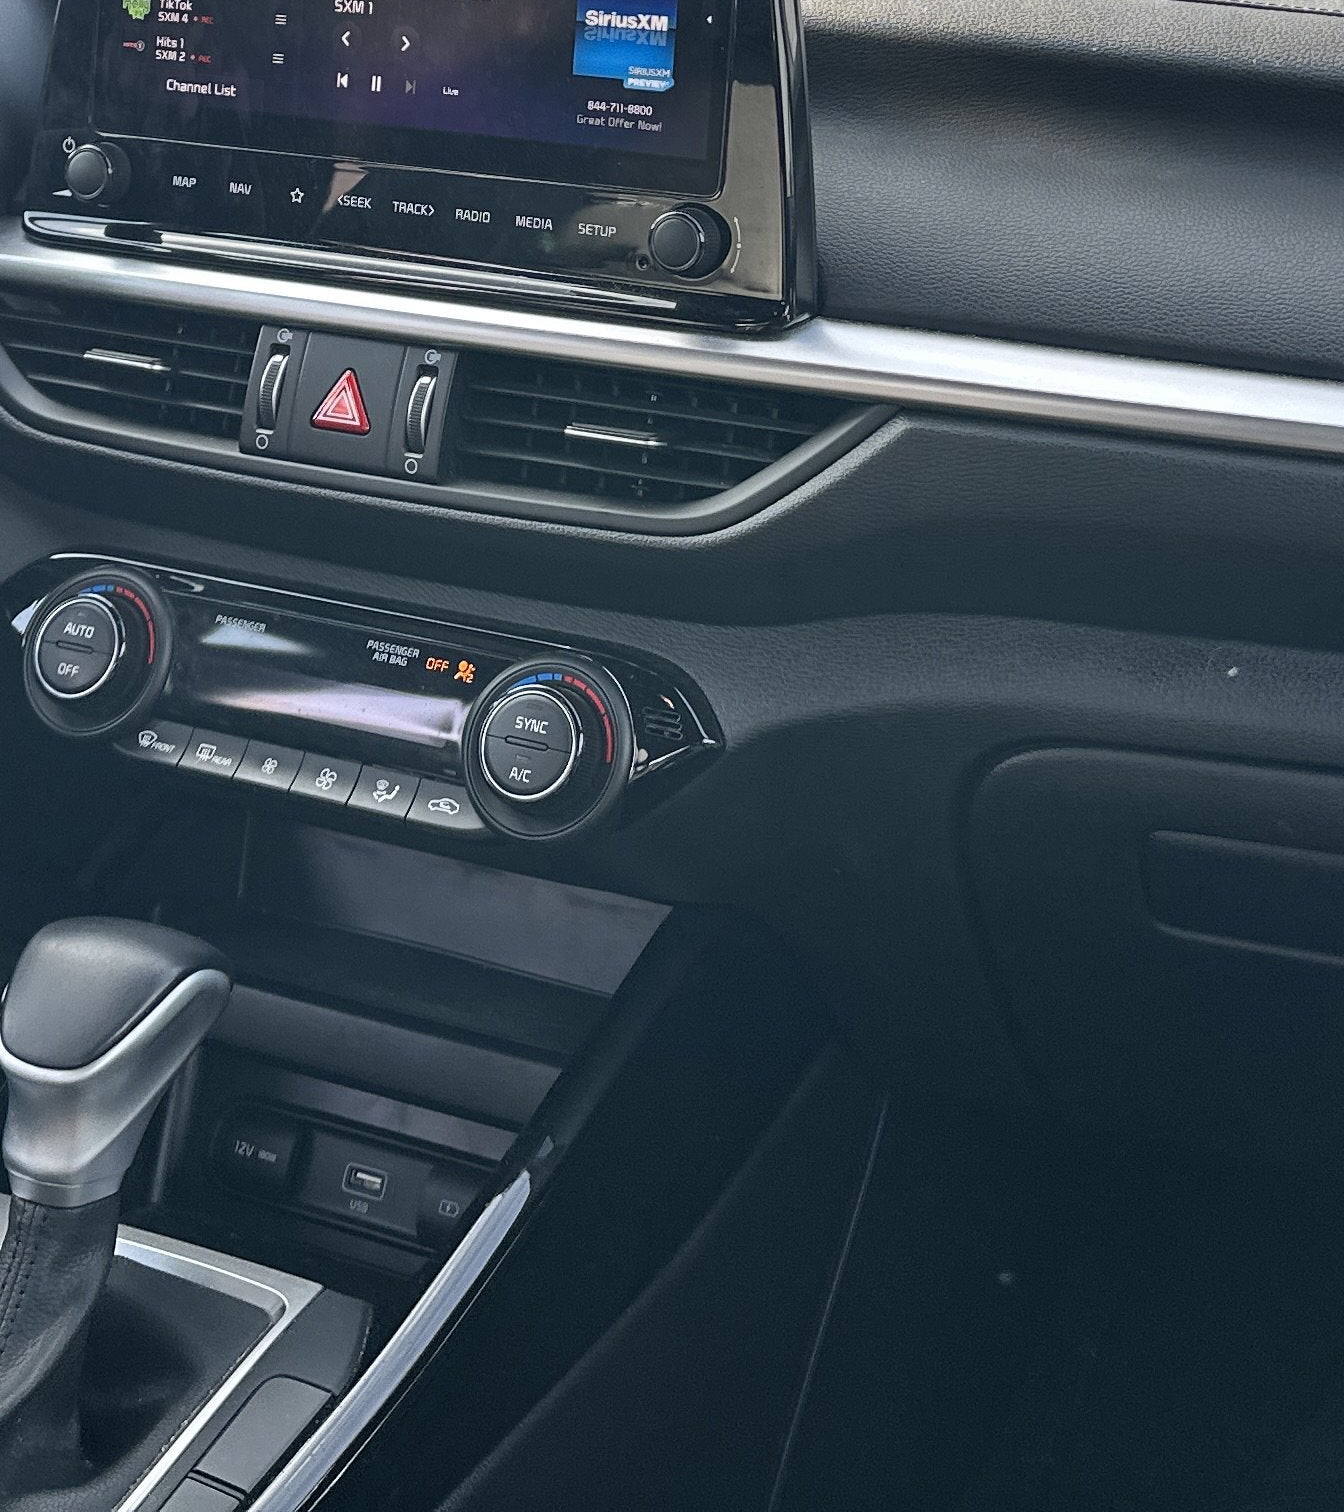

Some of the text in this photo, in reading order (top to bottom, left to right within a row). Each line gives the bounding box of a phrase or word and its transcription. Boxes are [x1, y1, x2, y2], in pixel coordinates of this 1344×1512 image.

[334, 0, 373, 15] SXM 1
[158, 11, 180, 23] SXM
[182, 13, 189, 24] 4
[585, 10, 669, 32] SiriusXM
[156, 36, 185, 49] Hits 1
[155, 49, 177, 61] SXM
[178, 51, 186, 62] 2
[166, 78, 237, 97] Channel List
[576, 114, 663, 133] Great Offer Now!
[172, 175, 197, 188] MAP
[229, 182, 252, 195] NAV
[455, 208, 491, 223] RADIO
[515, 215, 553, 231] MEDIA
[577, 223, 617, 238] SETUP
[63, 621, 95, 639] AUTO
[215, 614, 267, 633] PASSENGER
[366, 639, 420, 659] PASSENGER
[372, 651, 408, 667] AIR BAG
[425, 657, 450, 673] OFF
[57, 662, 80, 677] OFF
[514, 715, 549, 734] SYNC
[151, 740, 176, 754] FRONT
[508, 766, 532, 783] A/C
[234, 1139, 255, 1157] 12V
[349, 1199, 369, 1214] USB
